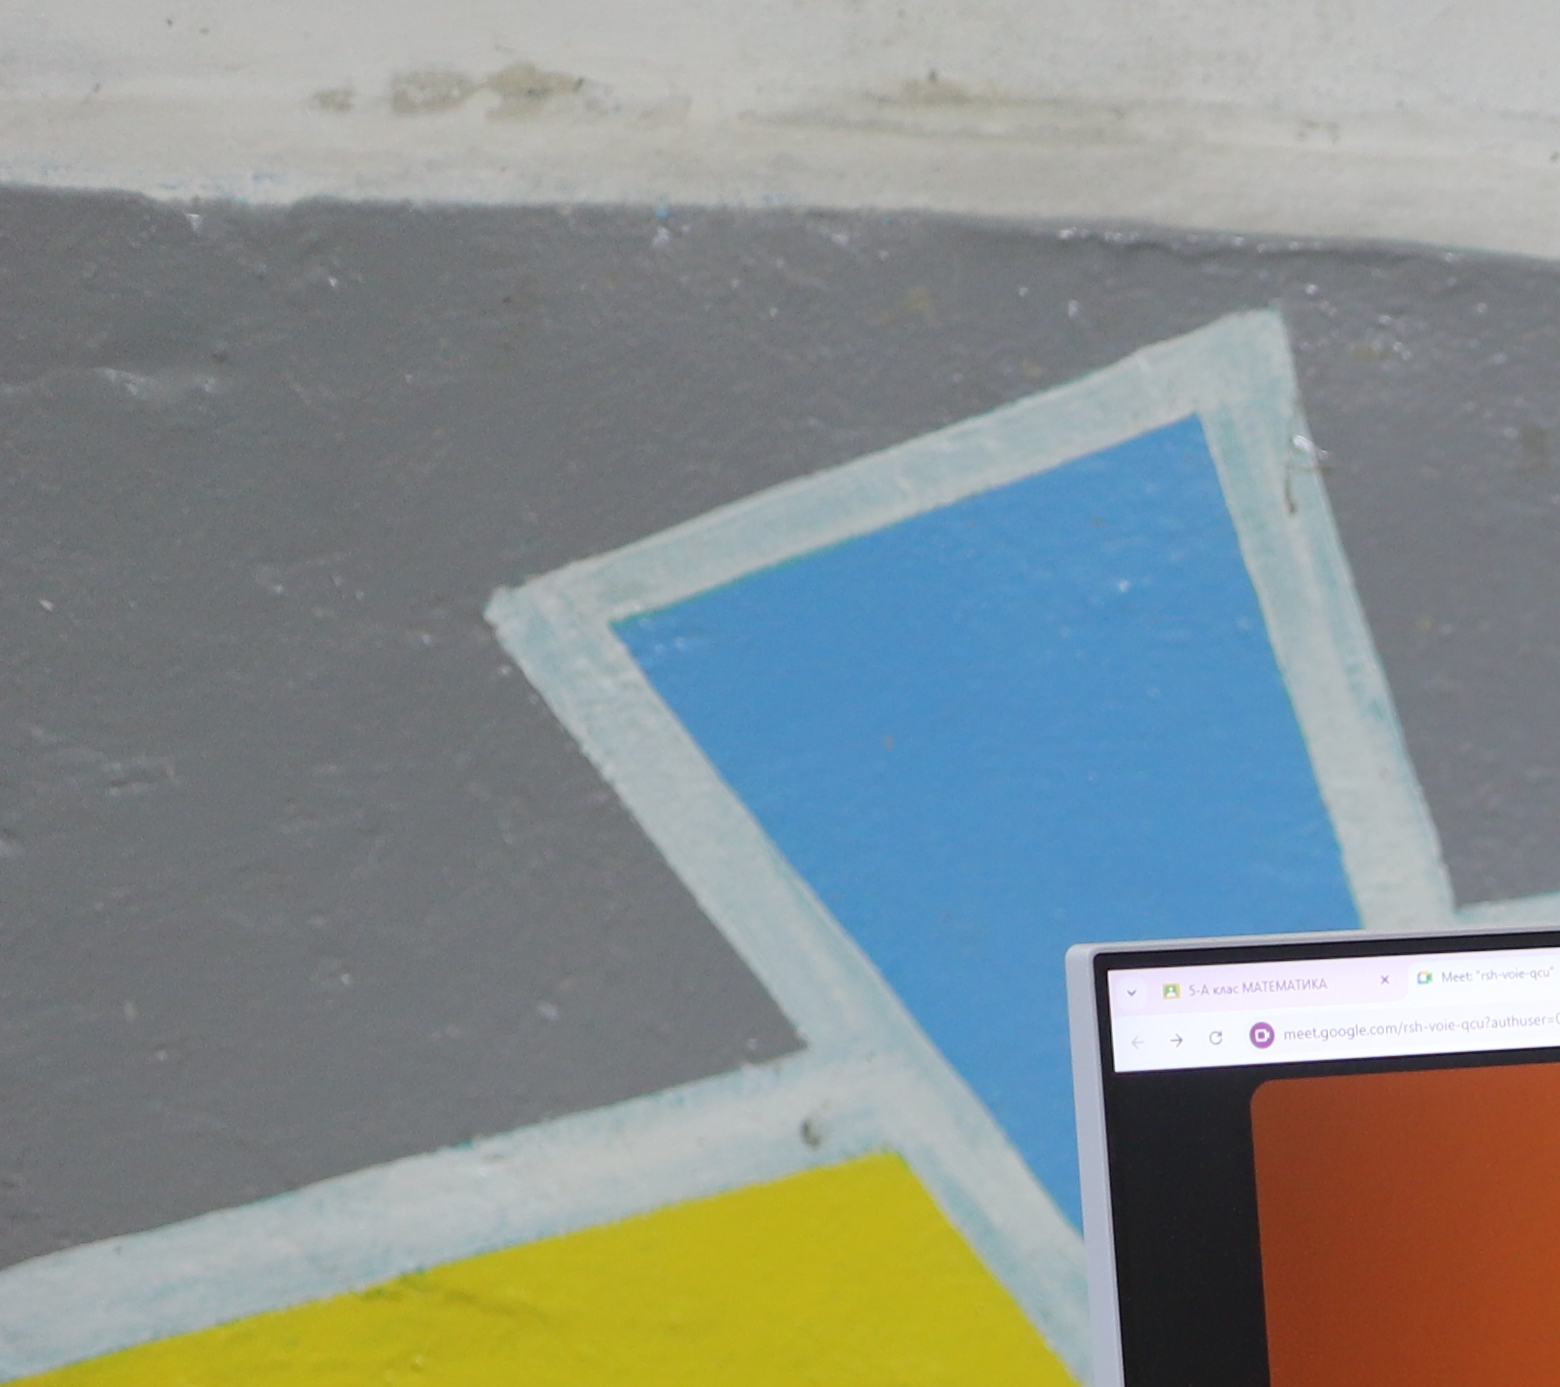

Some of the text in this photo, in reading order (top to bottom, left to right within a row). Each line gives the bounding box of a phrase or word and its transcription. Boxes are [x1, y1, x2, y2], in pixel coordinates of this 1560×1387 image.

[1441, 971, 1474, 983] Meet:
[1213, 984, 1239, 996] клас
[1242, 978, 1328, 993] МАТЕМАТИКА
